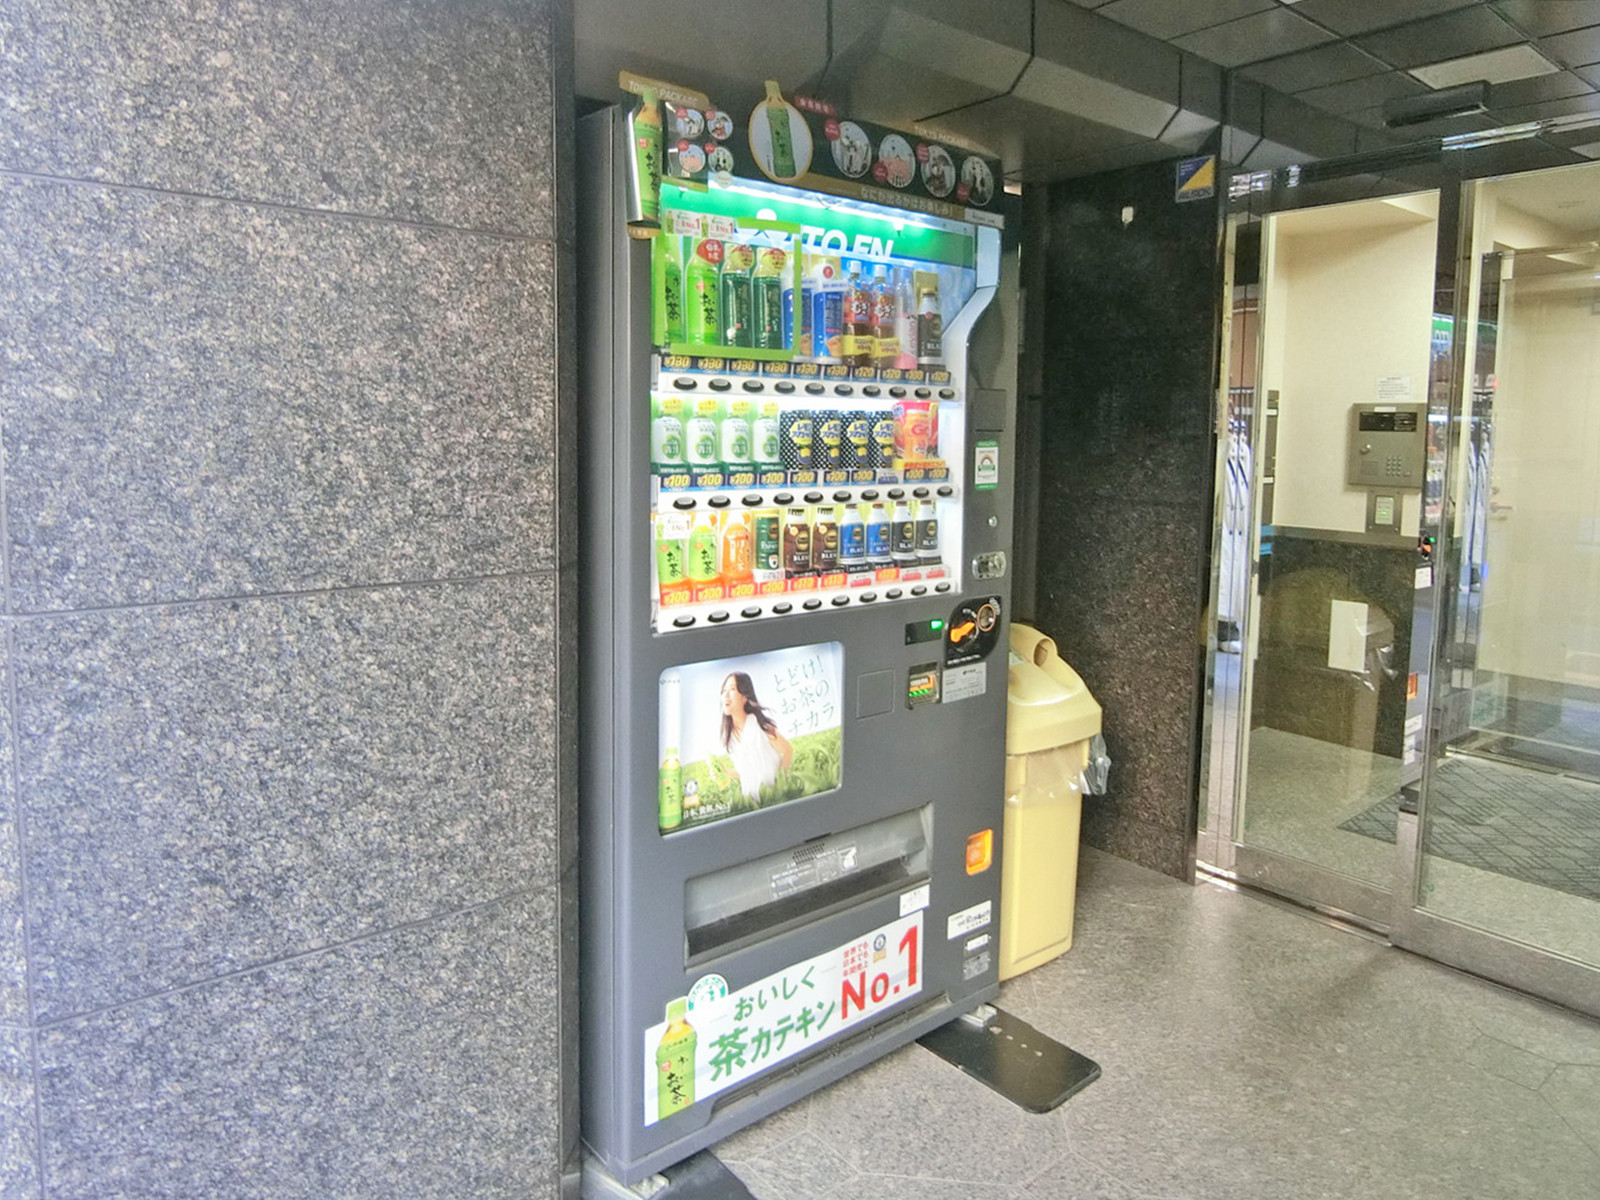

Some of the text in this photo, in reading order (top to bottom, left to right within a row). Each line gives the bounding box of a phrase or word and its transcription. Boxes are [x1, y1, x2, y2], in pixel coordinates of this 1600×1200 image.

[782, 680, 830, 715] お茶の
[789, 705, 835, 737] チカラ
[734, 965, 816, 1022] おいしく
[841, 924, 918, 1020] No.1
[708, 1000, 836, 1082] 茶カテキン
